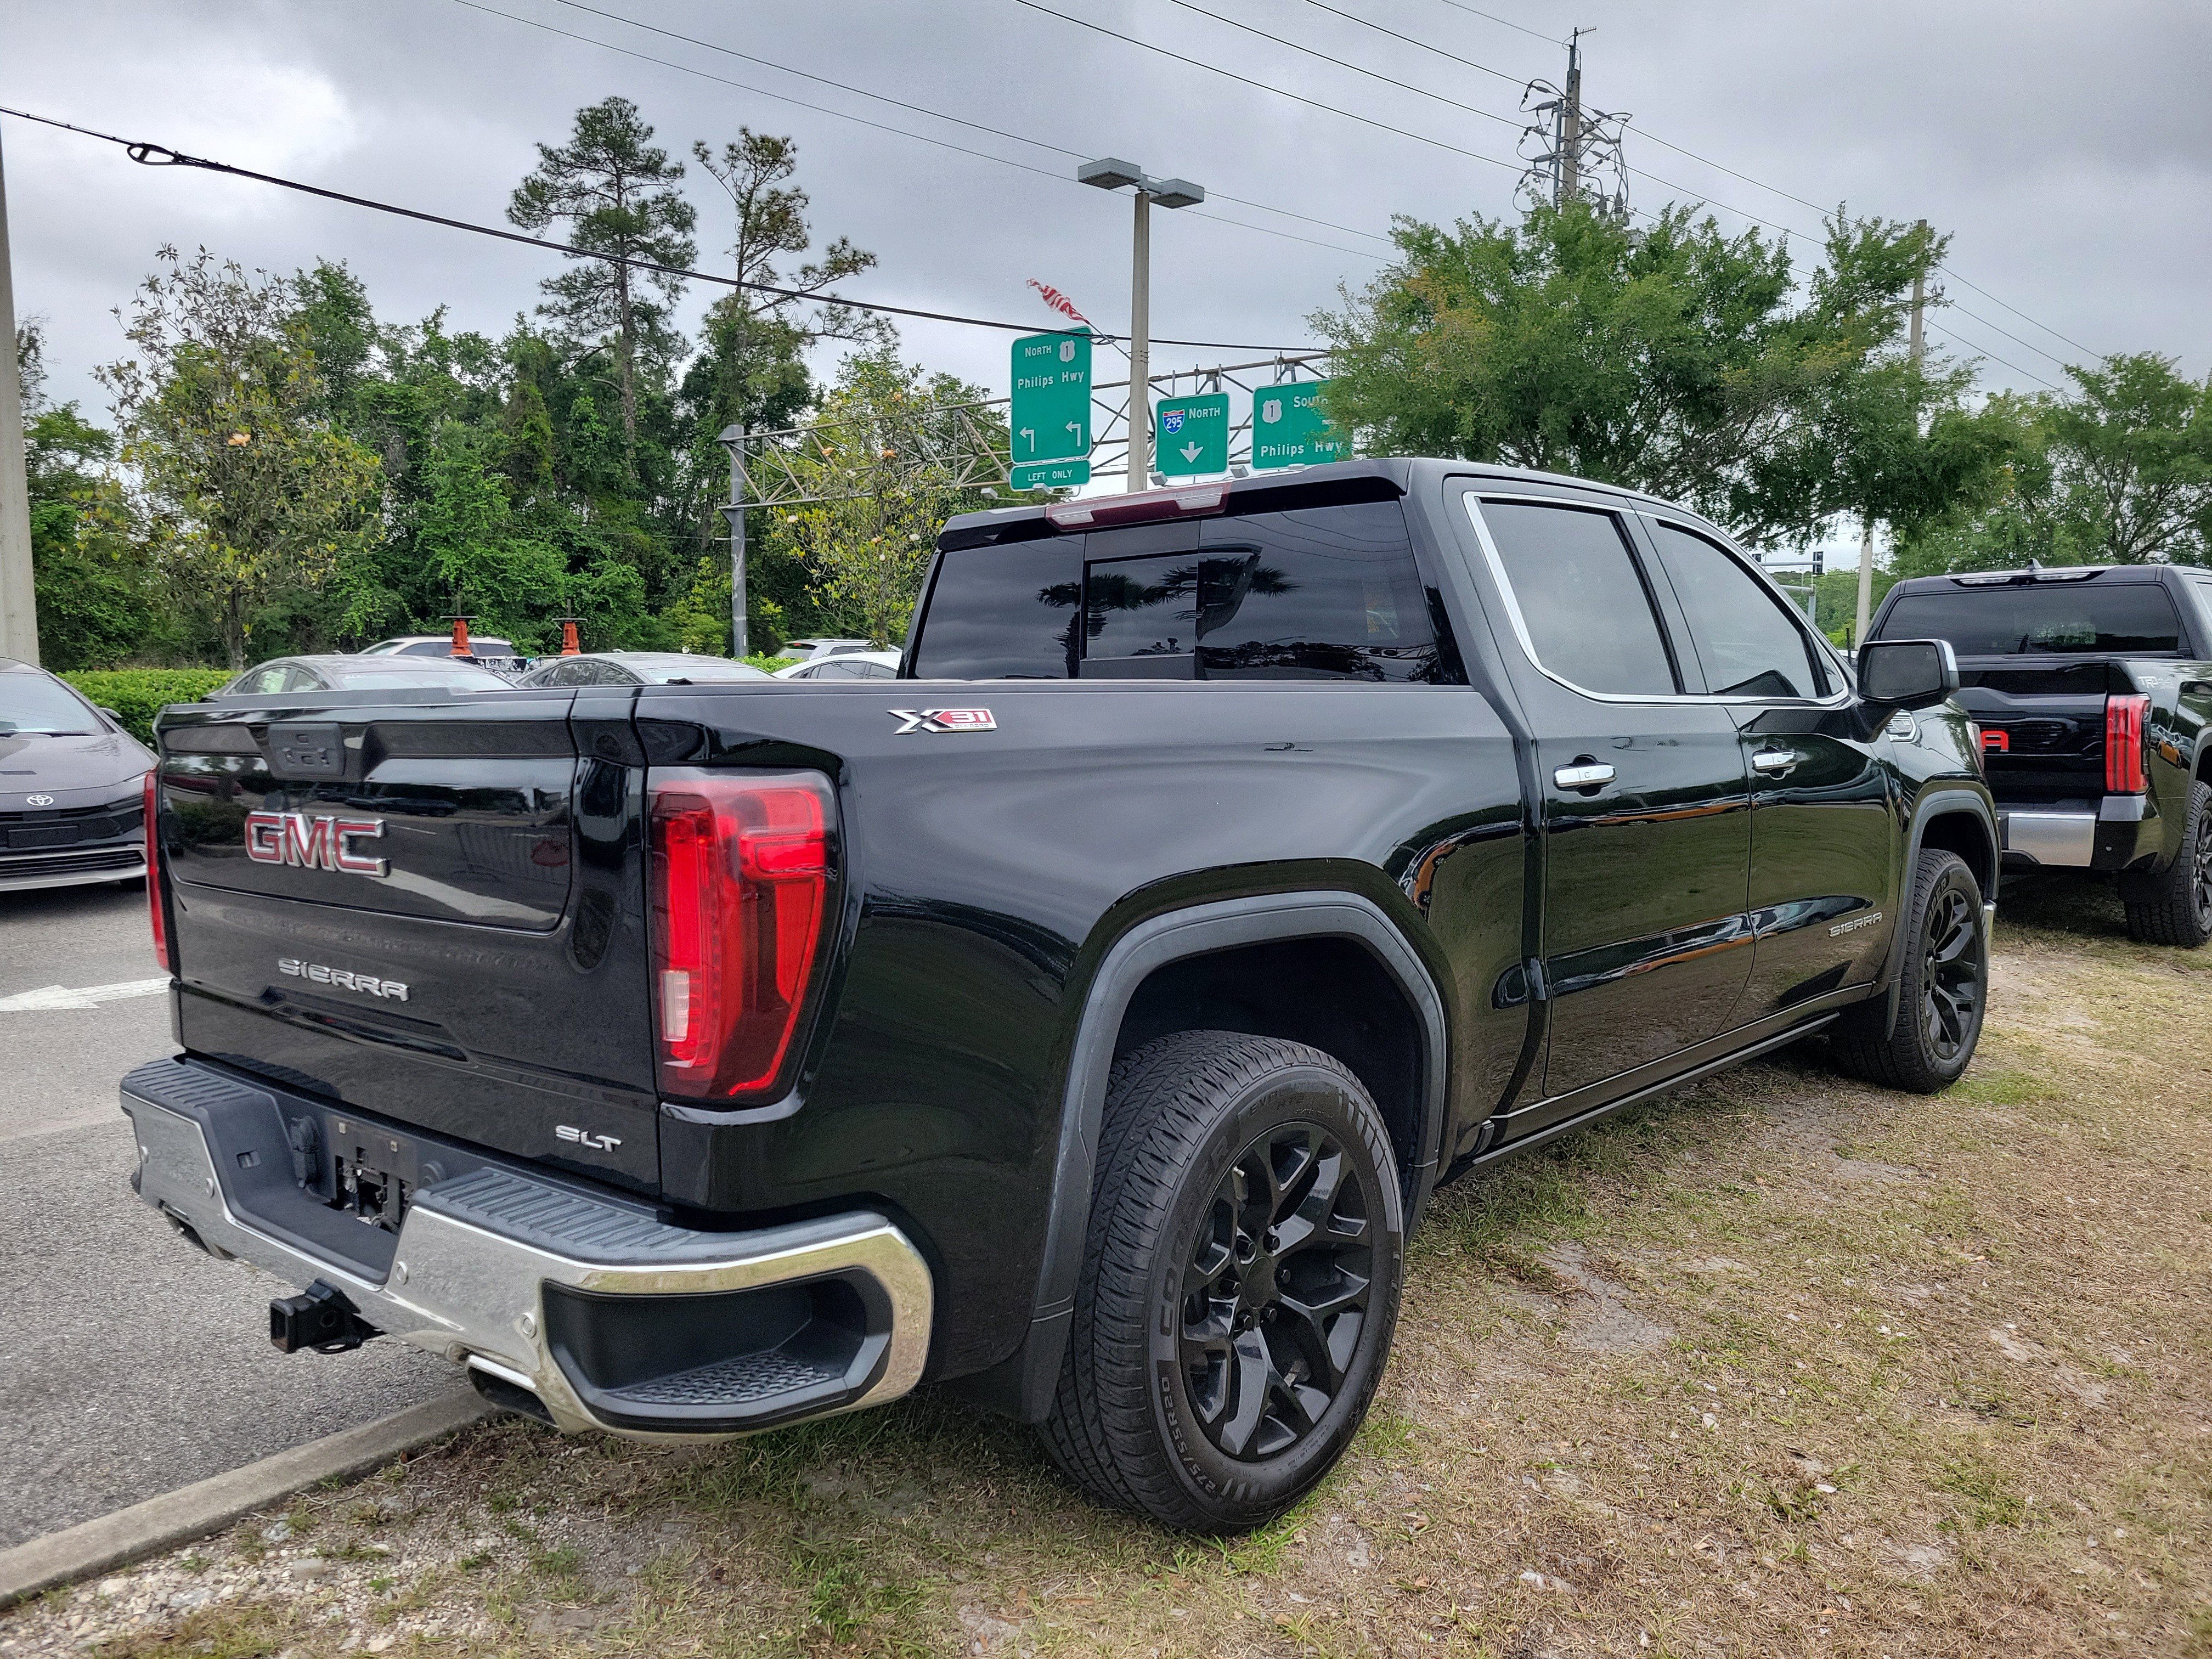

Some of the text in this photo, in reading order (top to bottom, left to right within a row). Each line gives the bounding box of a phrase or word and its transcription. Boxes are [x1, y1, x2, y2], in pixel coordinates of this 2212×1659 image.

[1025, 345, 1069, 357] NORTH 1
[1018, 371, 1084, 389] Philips Hwy
[1166, 407, 1221, 429] 295 NORTH
[1270, 404, 1274, 417] 1
[1261, 443, 1305, 458] Philips
[1028, 469, 1073, 481] LEFT ONLY
[245, 811, 389, 878] GMC
[1828, 912, 1883, 938] SIERRA
[278, 957, 410, 1002] SIERRA
[556, 1125, 622, 1153] SLT
[1161, 1376, 1216, 1493] 275/55R20
